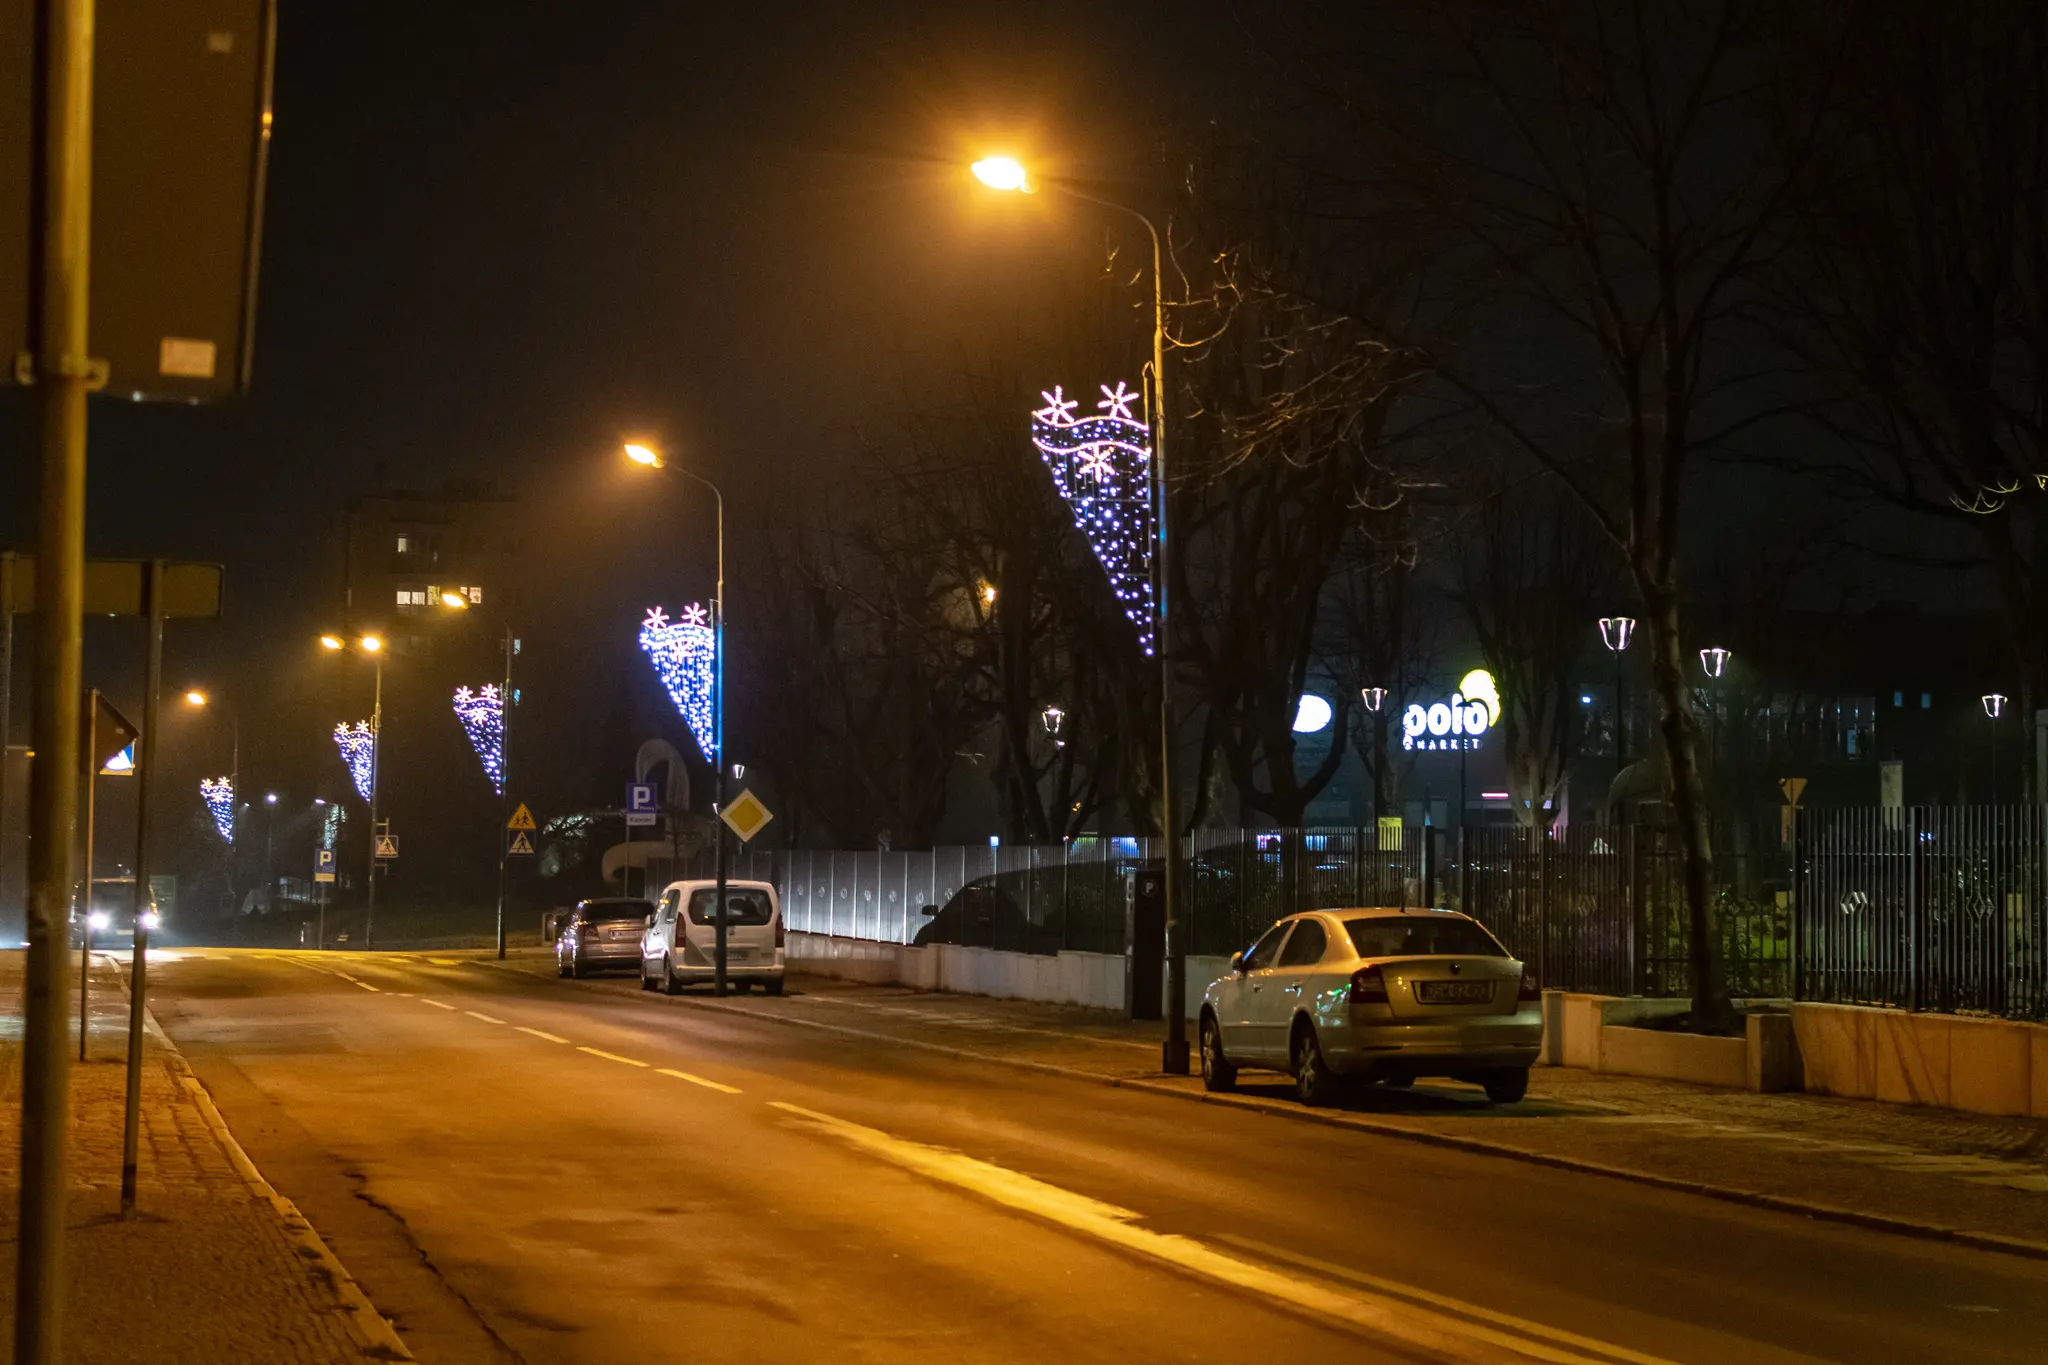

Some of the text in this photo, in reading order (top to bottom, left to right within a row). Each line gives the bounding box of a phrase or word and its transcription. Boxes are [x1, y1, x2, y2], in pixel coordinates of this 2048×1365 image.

[1403, 693, 1488, 749] polo
[634, 786, 650, 809] P
[320, 851, 332, 866] P
[1146, 882, 1154, 893] P
